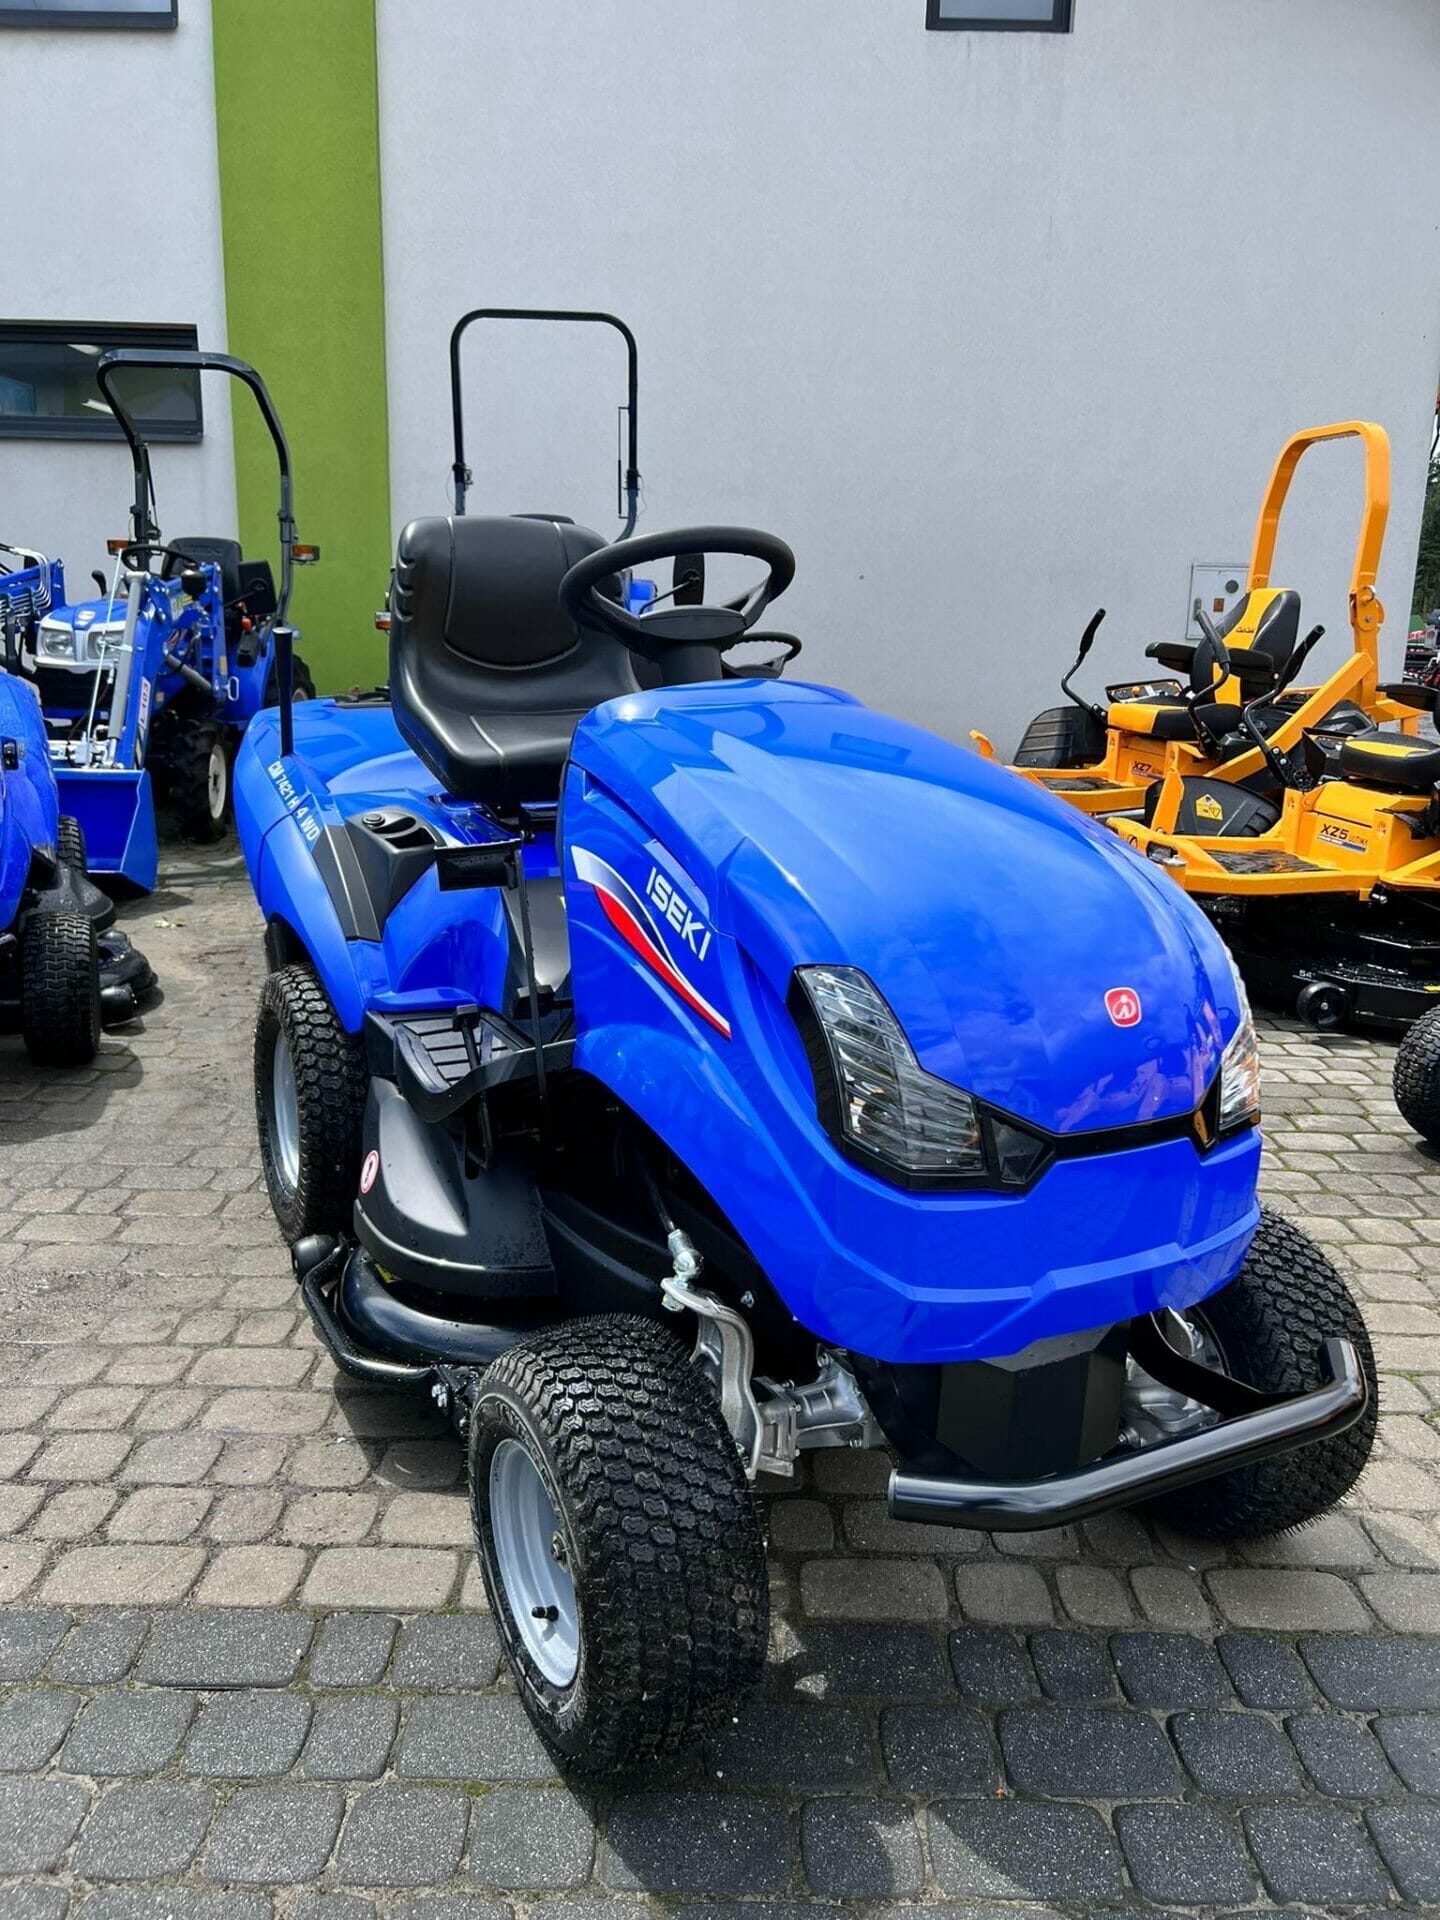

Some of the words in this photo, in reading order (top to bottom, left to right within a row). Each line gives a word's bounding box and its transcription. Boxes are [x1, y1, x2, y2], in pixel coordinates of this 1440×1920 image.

[1132, 760, 1152, 772] XZ7
[275, 775, 296, 801] 7421
[296, 806, 309, 819] 4
[300, 815, 321, 841] WD
[1320, 823, 1349, 840] XZ5
[645, 867, 711, 962] ISEKI
